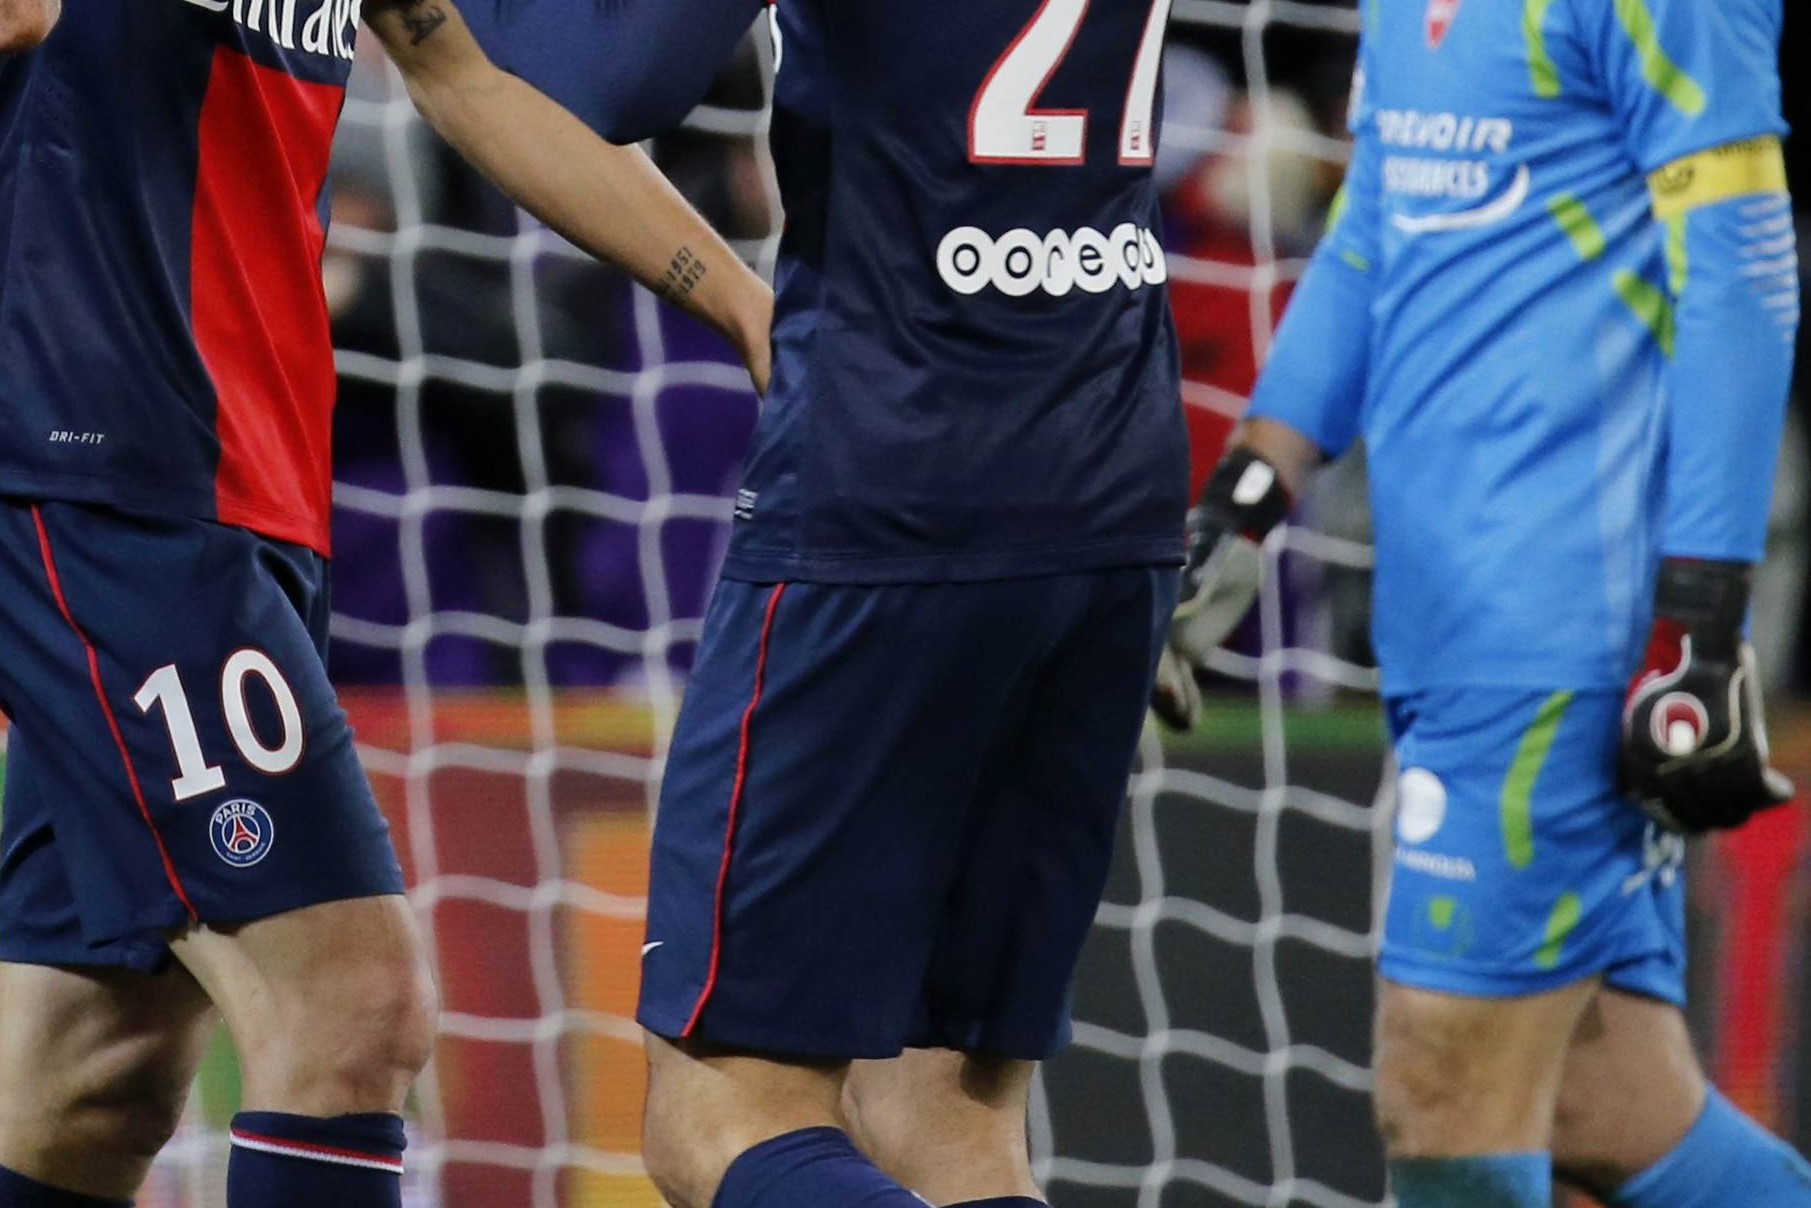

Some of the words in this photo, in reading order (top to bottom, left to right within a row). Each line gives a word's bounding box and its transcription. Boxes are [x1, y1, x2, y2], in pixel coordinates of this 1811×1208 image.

[49, 430, 105, 445] DRI-FIT
[133, 647, 306, 802] 10
[215, 803, 256, 825] PARIS
